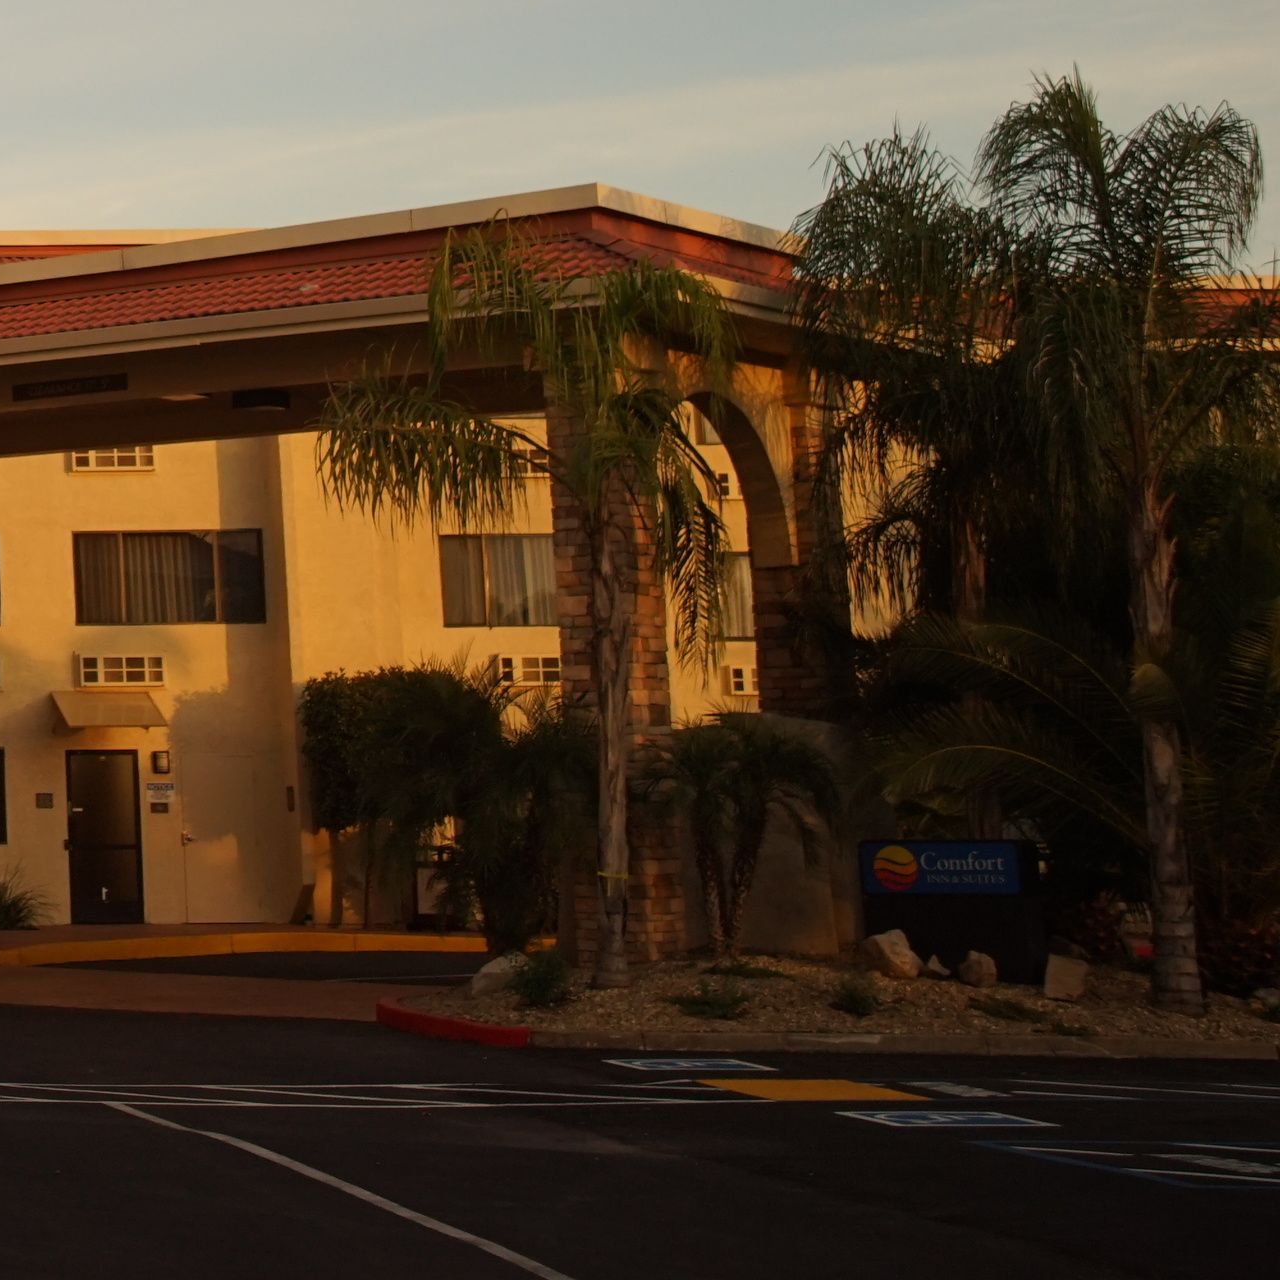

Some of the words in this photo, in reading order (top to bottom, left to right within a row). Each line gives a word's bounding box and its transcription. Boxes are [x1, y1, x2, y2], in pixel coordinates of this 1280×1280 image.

[920, 851, 1005, 872] Comfort
[927, 874, 950, 884] INN
[960, 874, 1008, 885] SUITES
